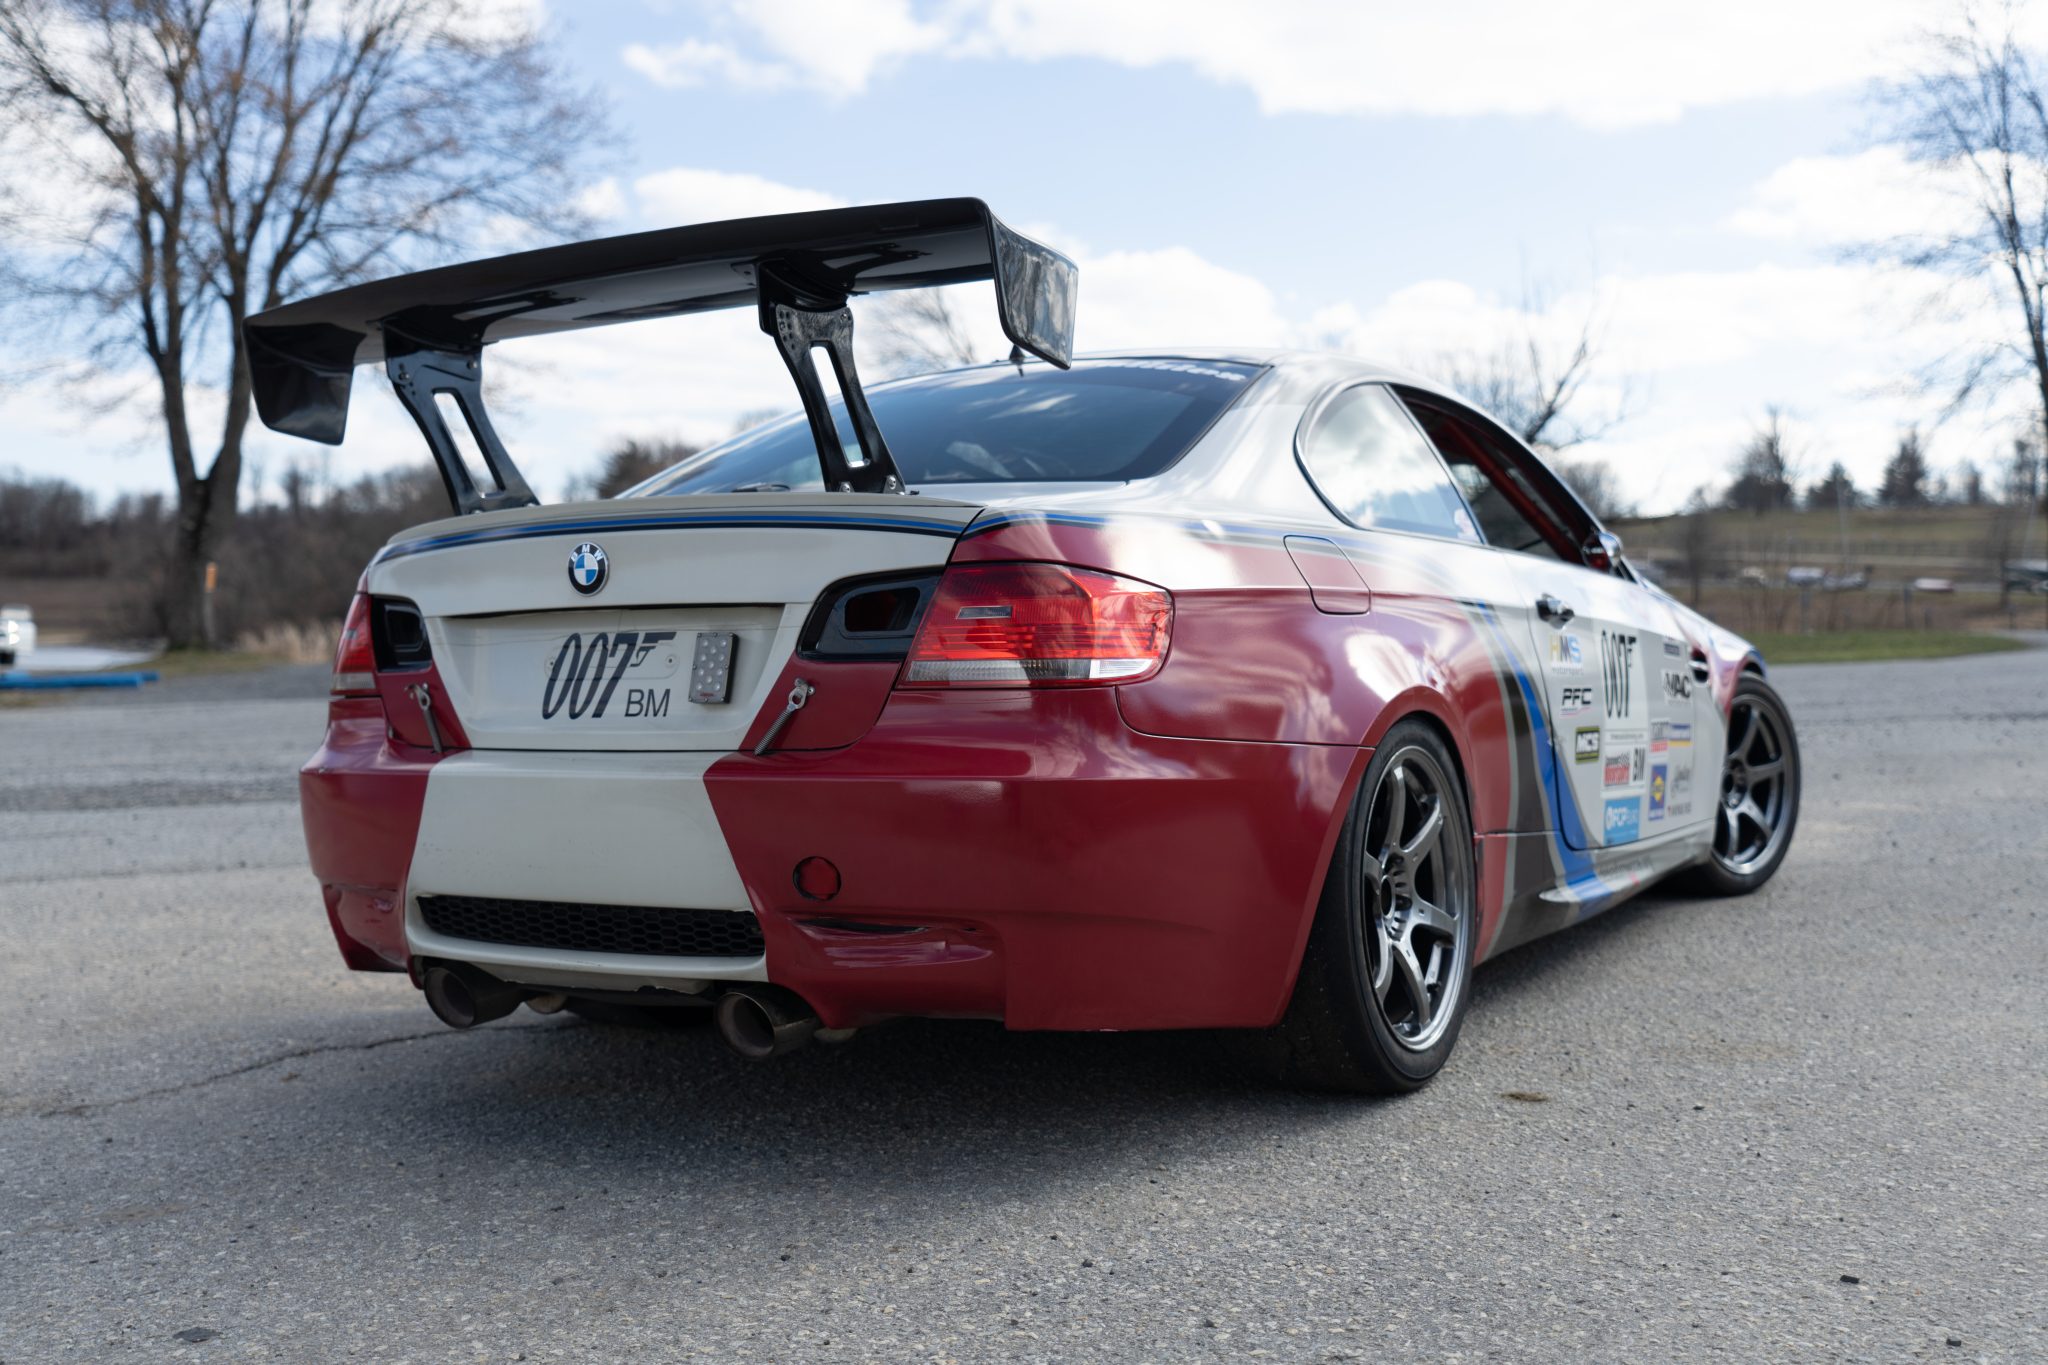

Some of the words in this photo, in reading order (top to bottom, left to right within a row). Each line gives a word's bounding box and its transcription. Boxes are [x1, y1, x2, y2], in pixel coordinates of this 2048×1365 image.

[570, 543, 605, 562] BMW
[1550, 633, 1583, 664] HMS
[542, 632, 640, 720] 007
[624, 688, 671, 718] BM
[1562, 688, 1592, 706] PFC
